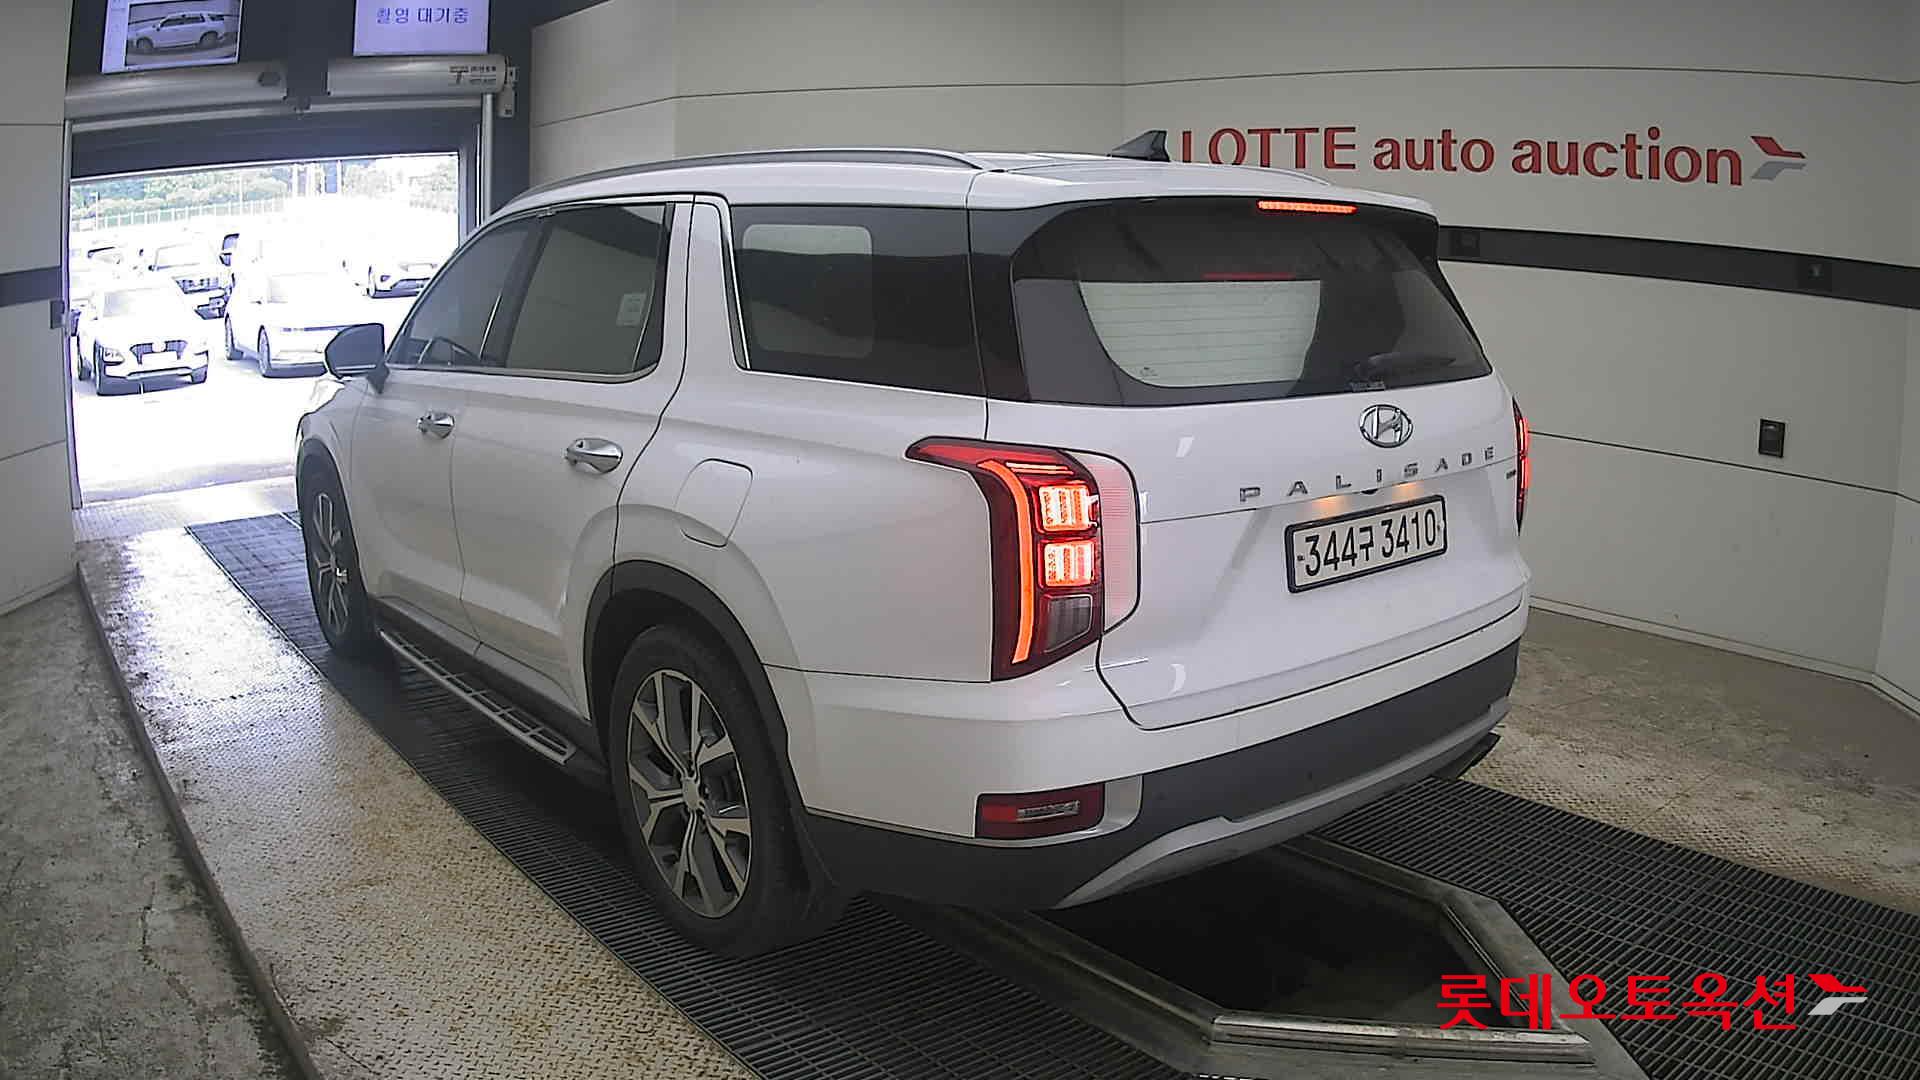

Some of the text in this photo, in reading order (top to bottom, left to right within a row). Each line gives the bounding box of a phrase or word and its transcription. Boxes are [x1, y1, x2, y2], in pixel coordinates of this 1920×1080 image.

[417, 7, 469, 24] 대기중
[1373, 129, 1495, 173] auto
[1511, 126, 1742, 186] auction
[1239, 446, 1495, 503] PALISADE
[1304, 508, 1437, 577] 344구 3410
